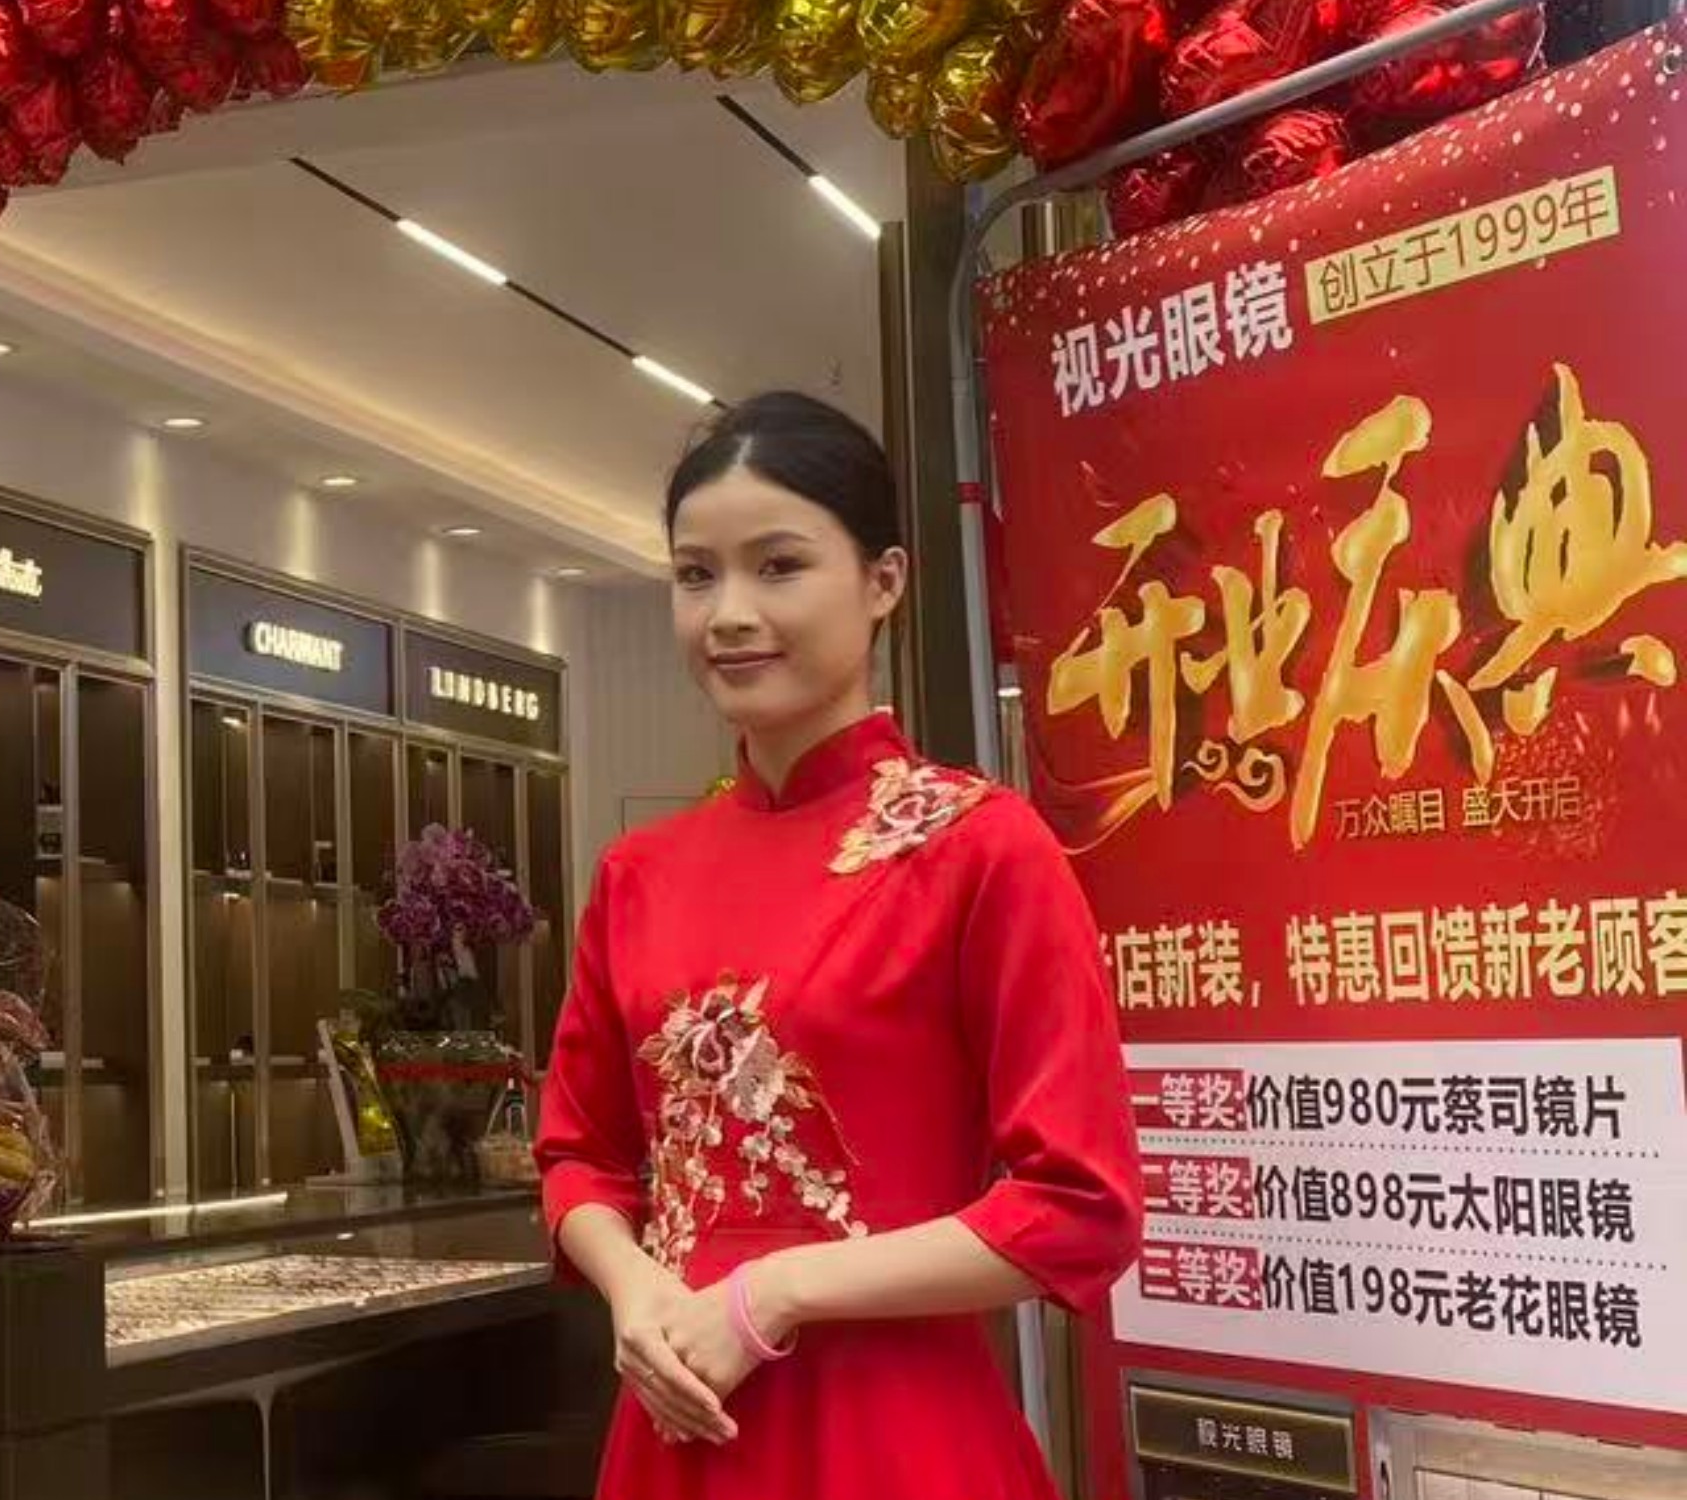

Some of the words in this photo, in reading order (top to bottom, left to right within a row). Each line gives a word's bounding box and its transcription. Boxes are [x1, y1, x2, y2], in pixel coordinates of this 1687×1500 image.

[1052, 260, 1293, 418] 视光眼镜
[1319, 177, 1610, 314] 创立于1999年
[1047, 363, 1687, 850] 开业庆典
[428, 665, 539, 721] LINDBERG
[1335, 787, 1446, 840] 万众瞩目
[1463, 776, 1582, 830] 盛大开启
[1100, 890, 1687, 1010] 店新装，特惠回馈新老顾客
